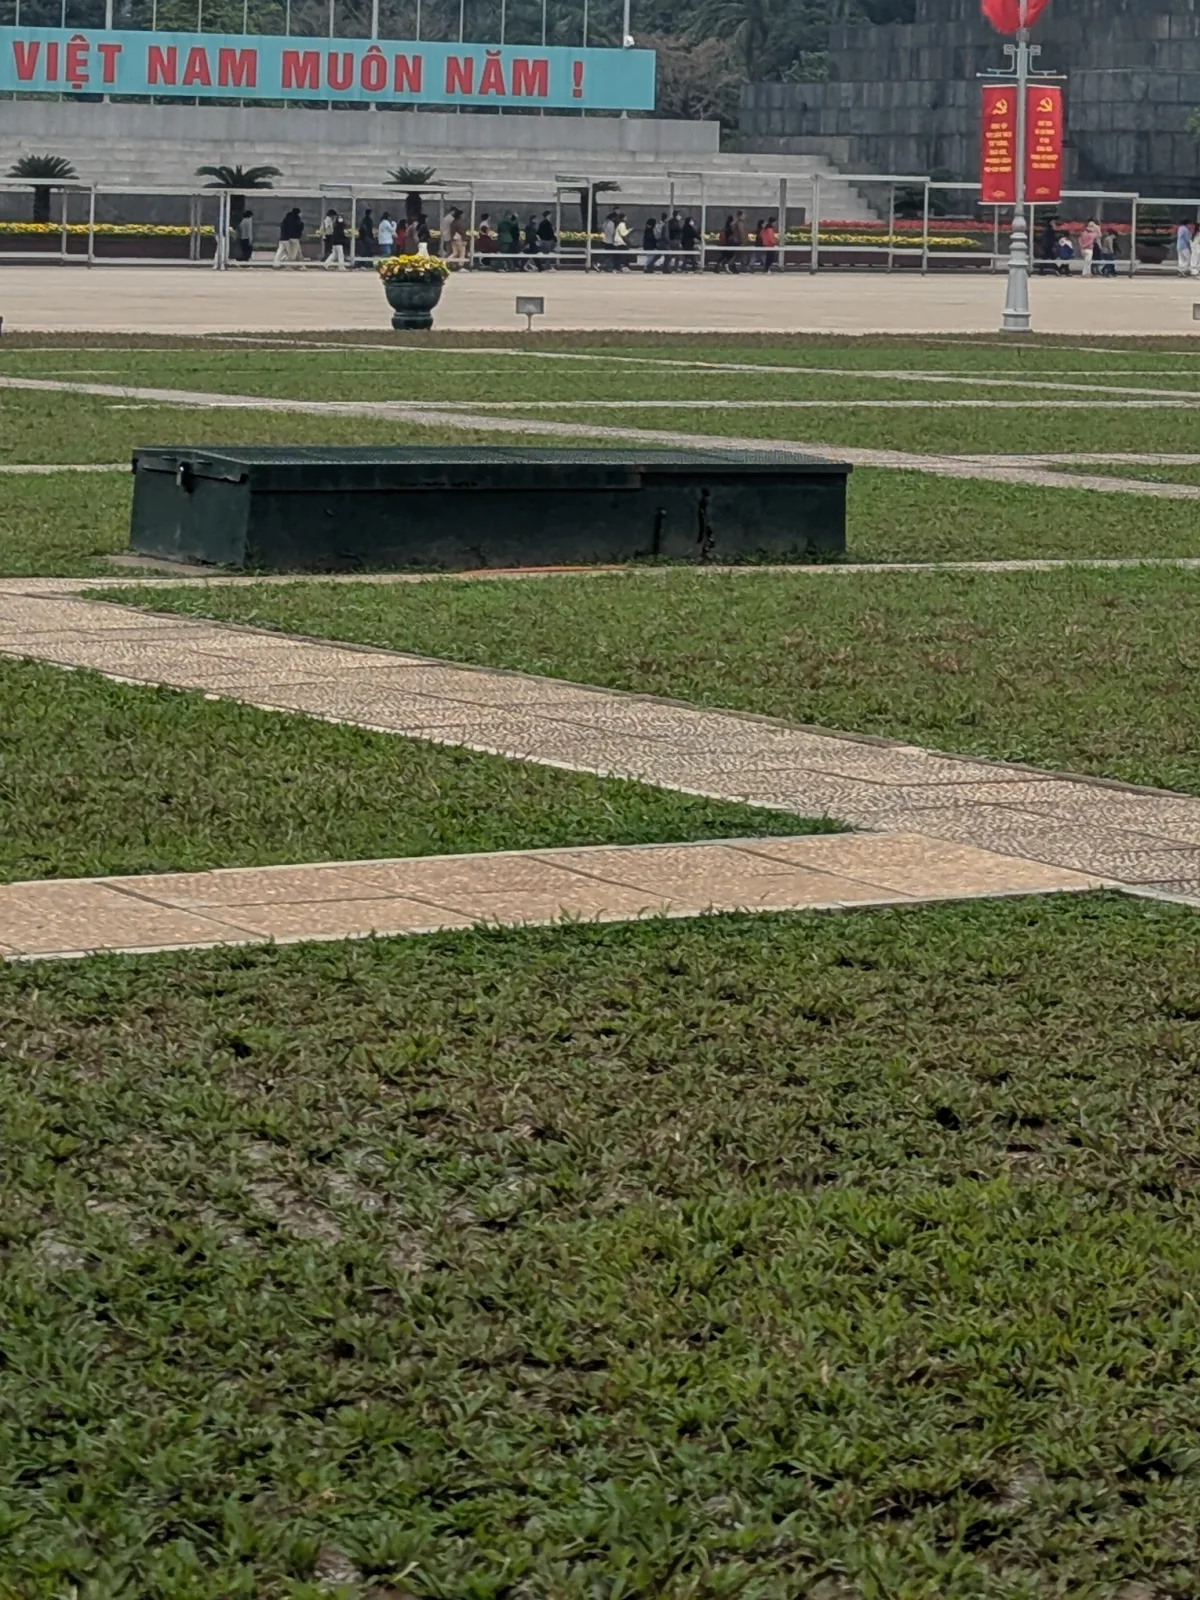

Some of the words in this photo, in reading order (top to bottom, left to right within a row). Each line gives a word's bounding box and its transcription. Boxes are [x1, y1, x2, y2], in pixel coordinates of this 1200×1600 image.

[12, 34, 123, 90] VIỆT
[146, 45, 258, 88] NAM
[281, 45, 423, 93] MUÔN
[445, 49, 550, 97] NĂM
